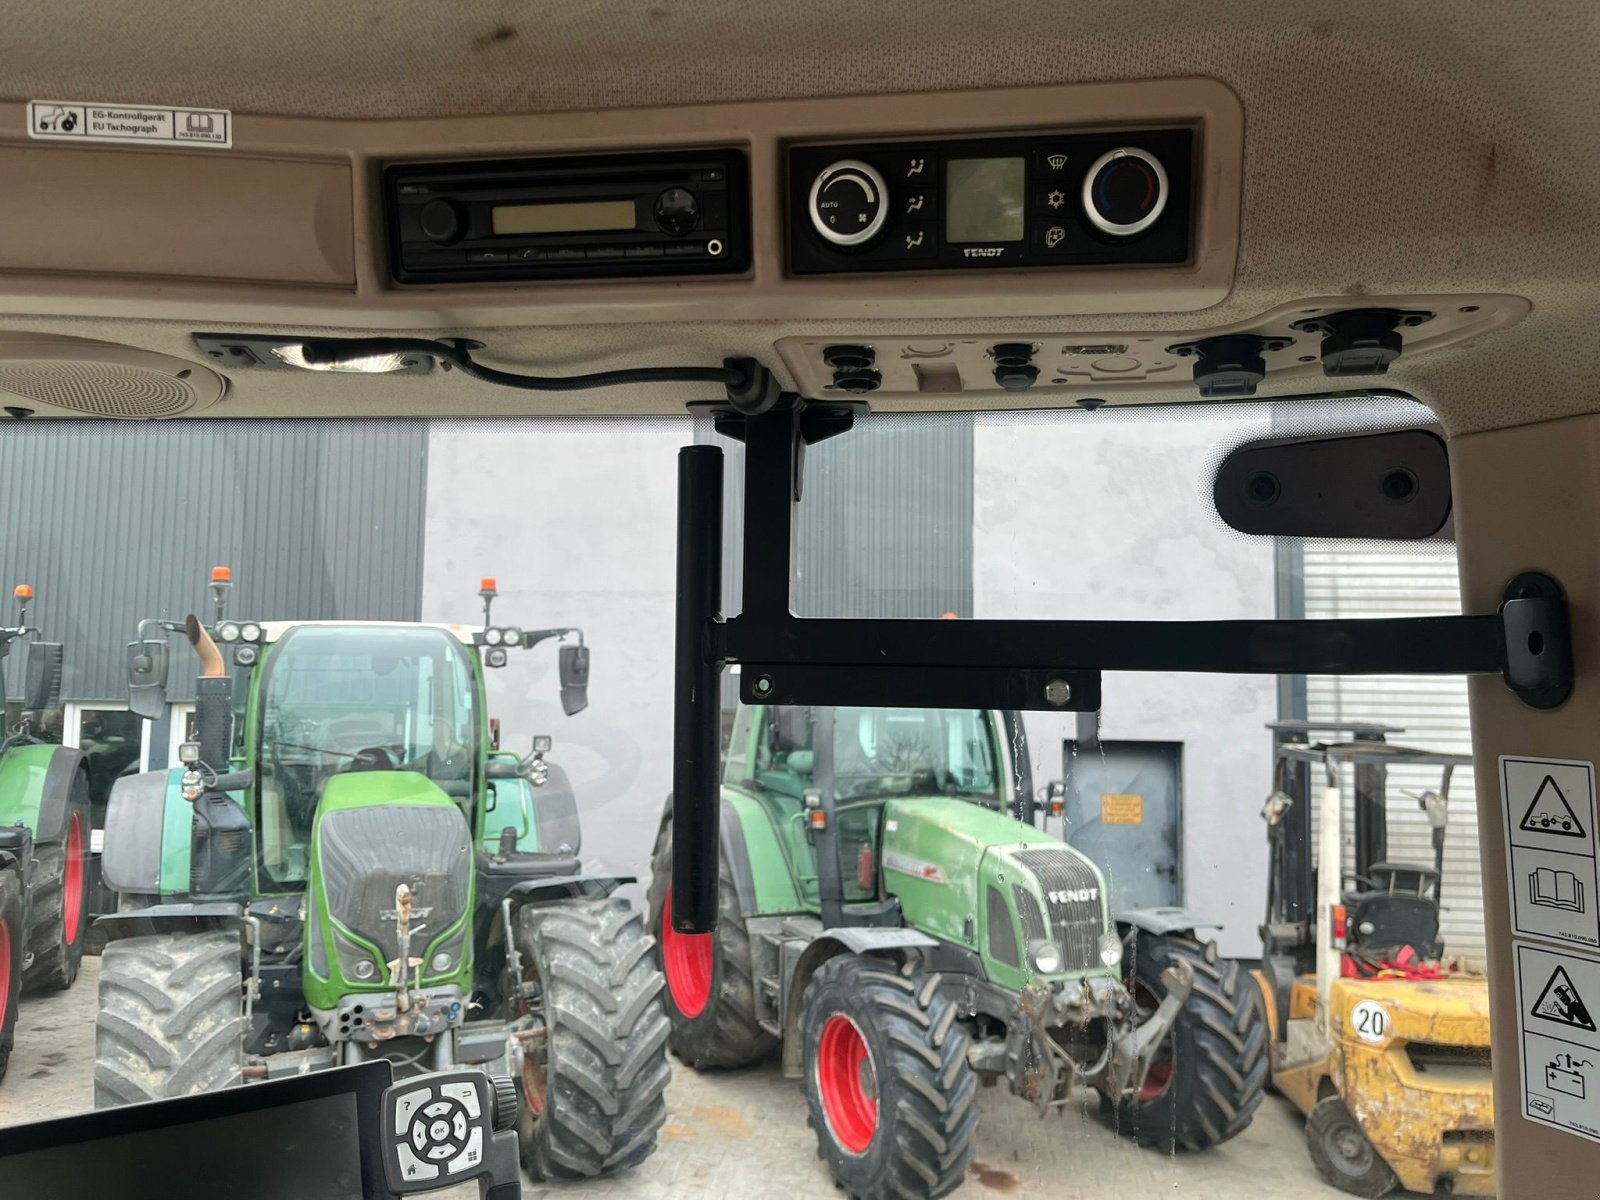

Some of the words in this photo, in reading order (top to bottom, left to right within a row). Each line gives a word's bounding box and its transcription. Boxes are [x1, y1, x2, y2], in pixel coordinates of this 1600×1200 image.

[92, 110, 166, 122] EG-Kontrollgerät
[92, 122, 105, 130] EU
[106, 122, 158, 134] Tachograph
[963, 247, 1005, 257] FENDT
[1048, 888, 1098, 904] FENDT
[1359, 1008, 1384, 1036] 20
[434, 1127, 445, 1135] OK
